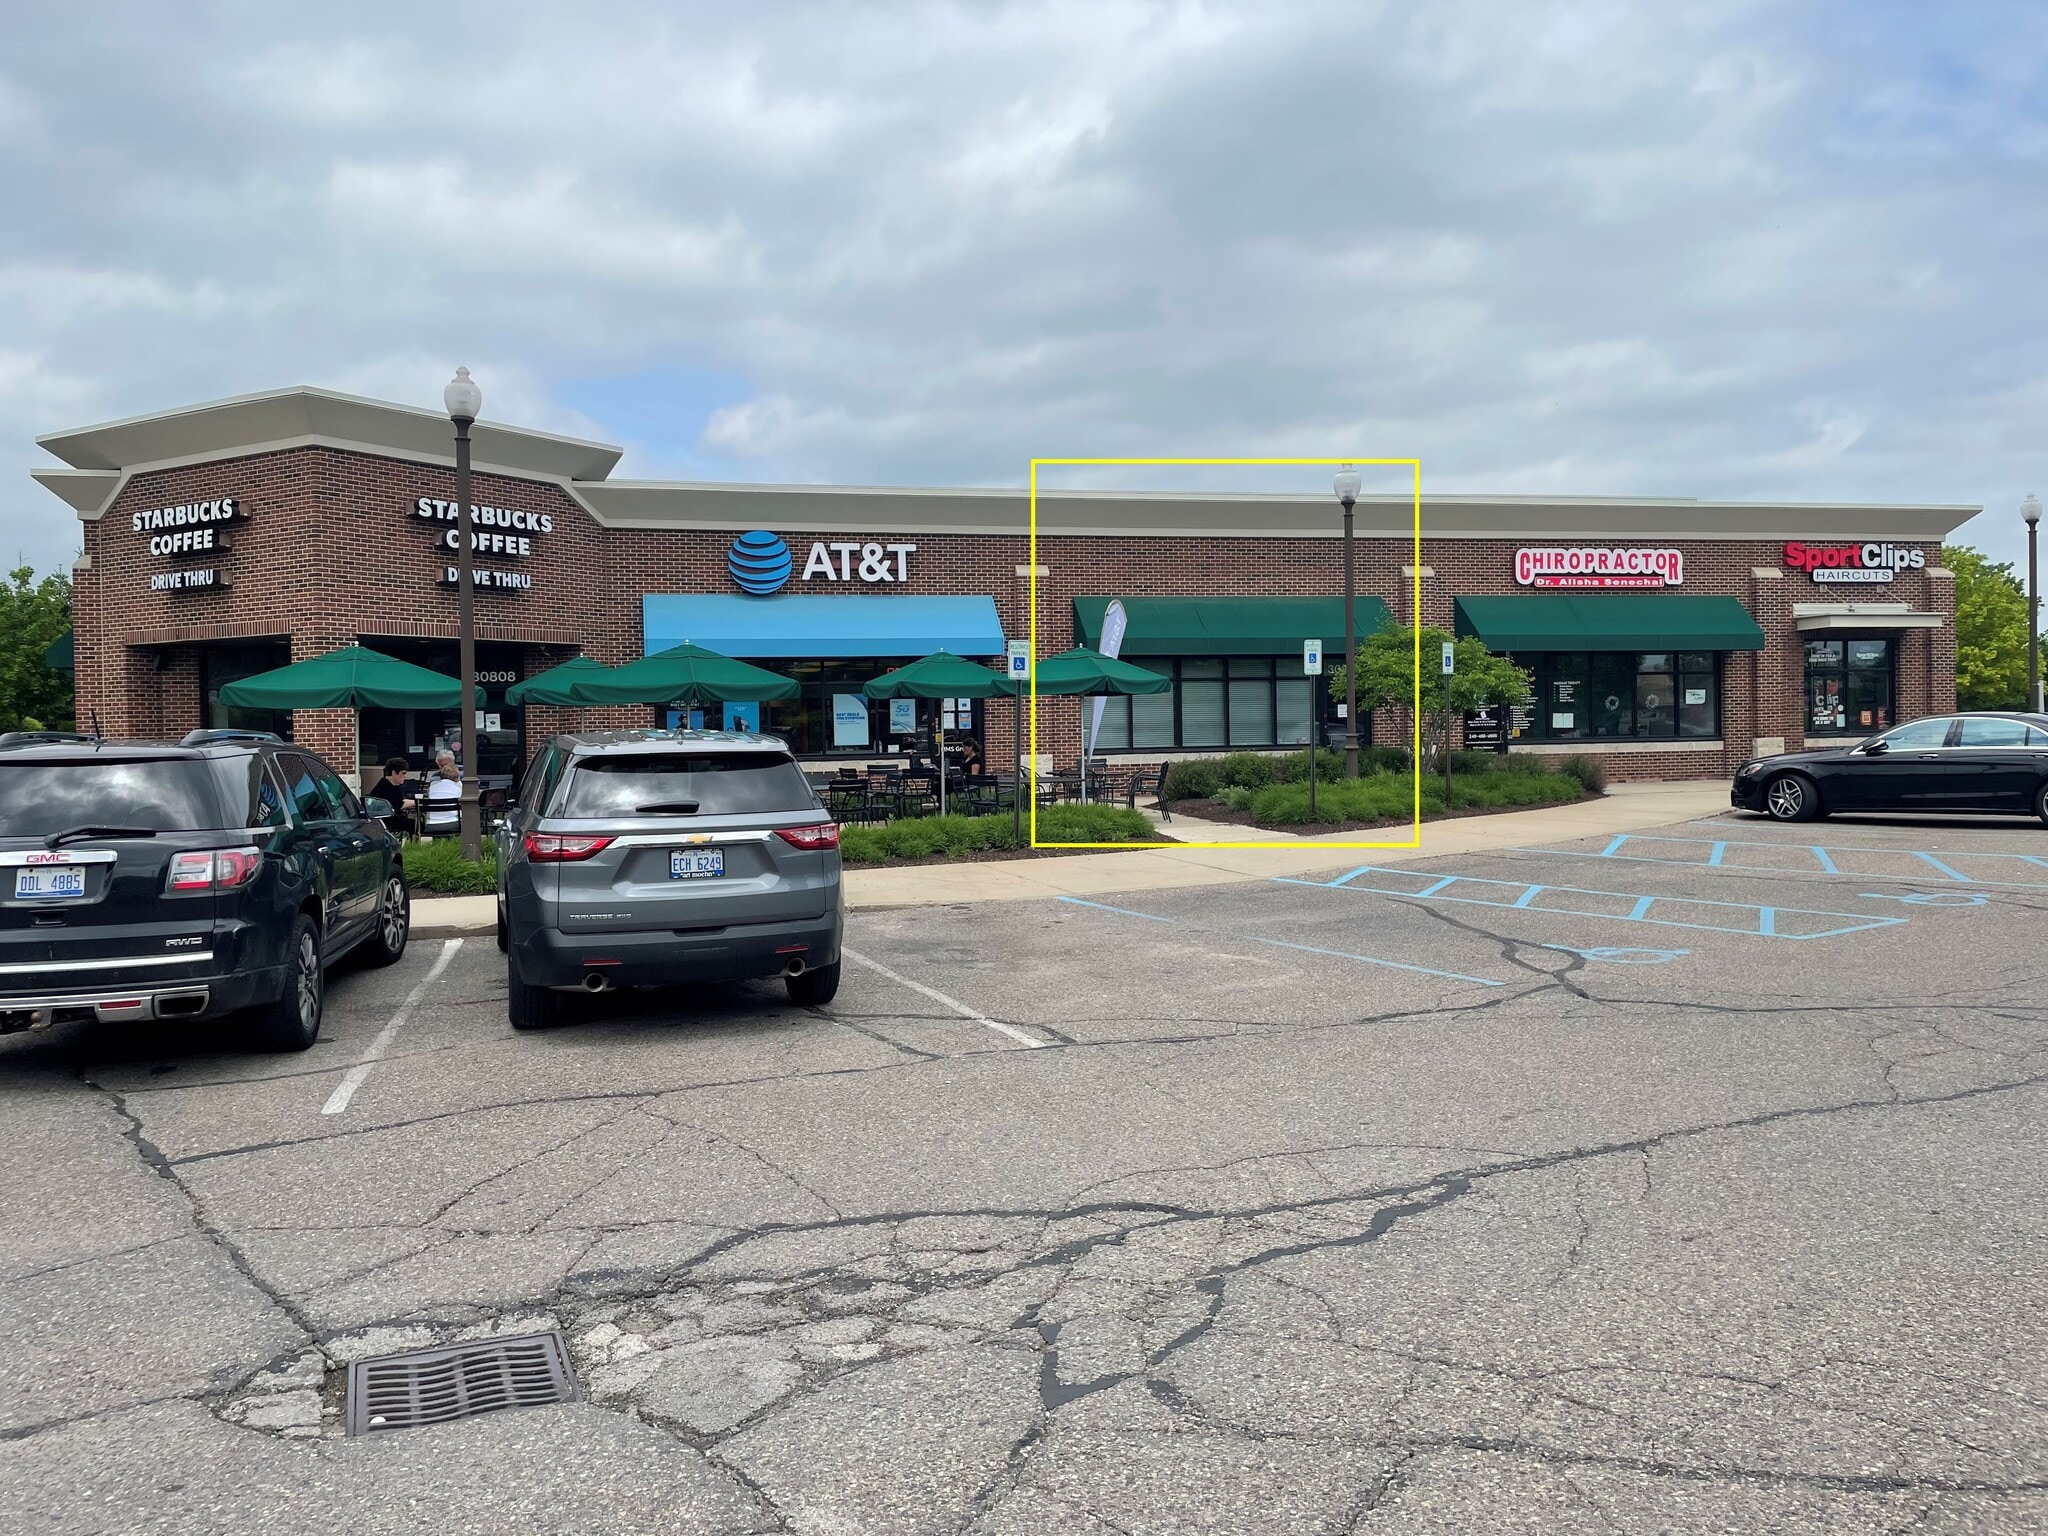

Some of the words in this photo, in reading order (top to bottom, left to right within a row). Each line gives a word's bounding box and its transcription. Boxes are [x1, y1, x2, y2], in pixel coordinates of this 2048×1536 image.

[132, 498, 233, 532] STARBUCKS
[418, 497, 553, 533] STARBUCKS
[150, 528, 213, 556] COFFEE
[802, 542, 917, 582] AT&T
[1519, 551, 1679, 581] CHIROPRACTOR
[151, 572, 182, 590] DRIVE
[183, 569, 214, 587] THRU
[447, 567, 491, 586] DVE
[493, 571, 531, 589] THRU
[1536, 578, 1554, 586] Dr.
[1559, 577, 1600, 586] Alisha
[1604, 577, 1663, 586] Senechal
[1816, 571, 1890, 580] HAIRCUTS
[895, 704, 910, 713] 5G
[26, 853, 71, 863] GMC
[673, 857, 691, 871] ECH
[697, 856, 722, 870] 6249
[20, 876, 42, 891] DDL
[51, 874, 81, 890] 4885
[165, 936, 203, 947] AWD
